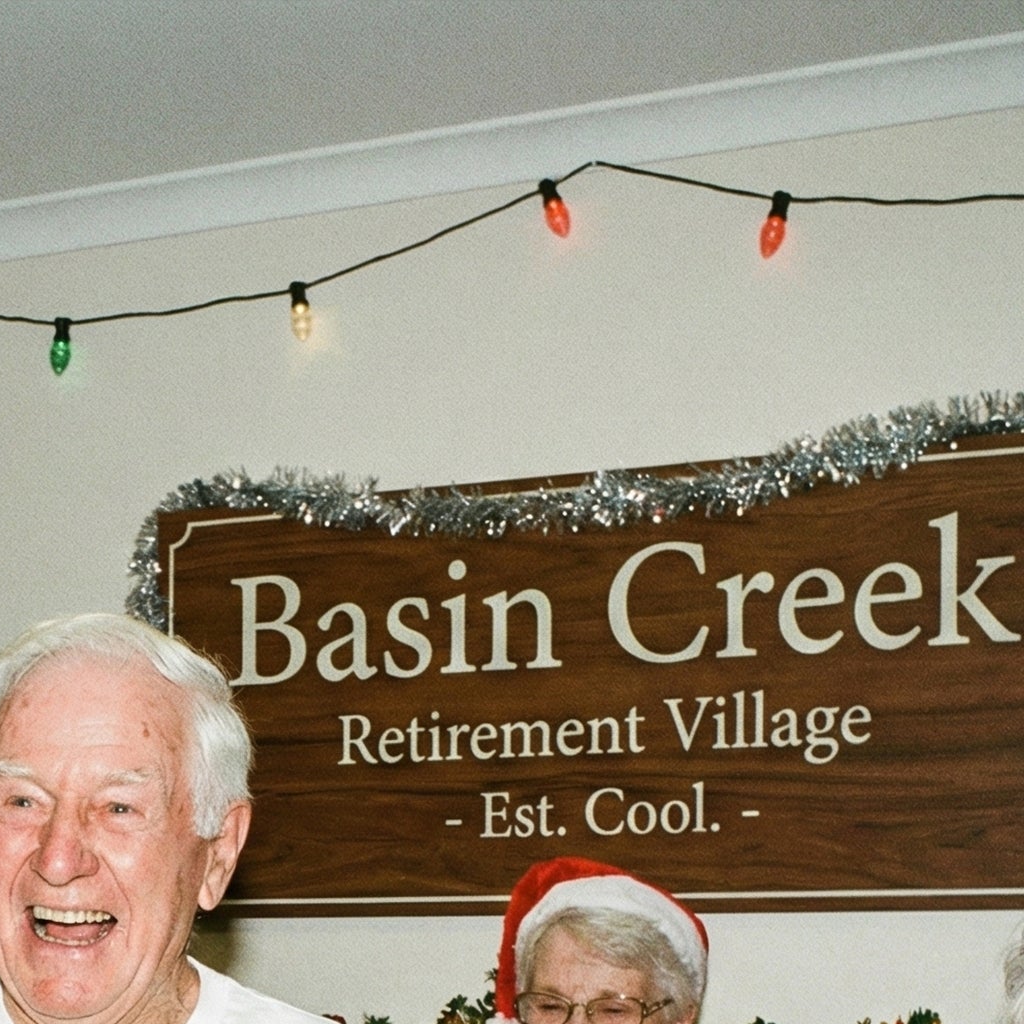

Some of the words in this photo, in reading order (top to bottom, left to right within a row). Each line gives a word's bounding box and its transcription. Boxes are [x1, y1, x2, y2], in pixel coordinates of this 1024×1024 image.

[229, 559, 563, 687] Basin
[607, 510, 1022, 666] Creek
[337, 708, 646, 766] Retirement
[663, 690, 873, 766] Village
[479, 792, 567, 840] Est.
[585, 782, 722, 837] Cool.
